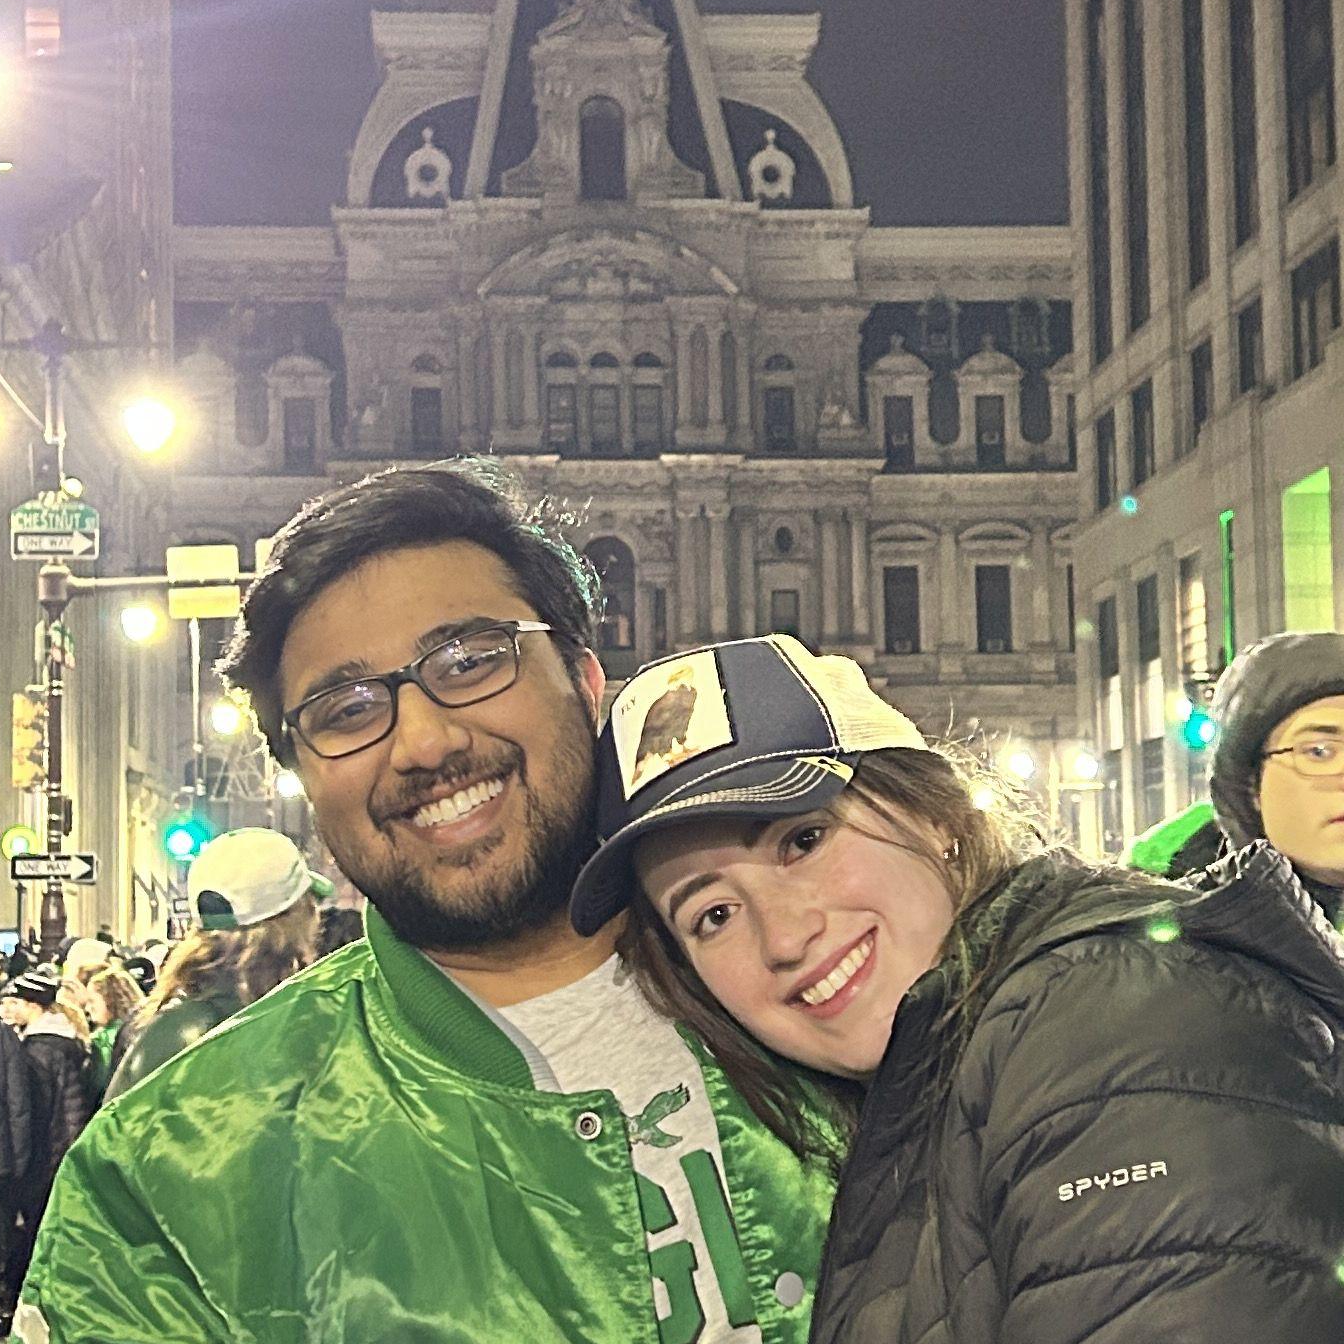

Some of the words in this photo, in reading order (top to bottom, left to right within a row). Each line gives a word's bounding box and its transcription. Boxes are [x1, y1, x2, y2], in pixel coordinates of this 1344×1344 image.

[16, 511, 81, 530] CHESTNUT
[621, 696, 636, 716] FLY
[47, 861, 68, 873] WAY
[1058, 1160, 1168, 1202] SPYDER
